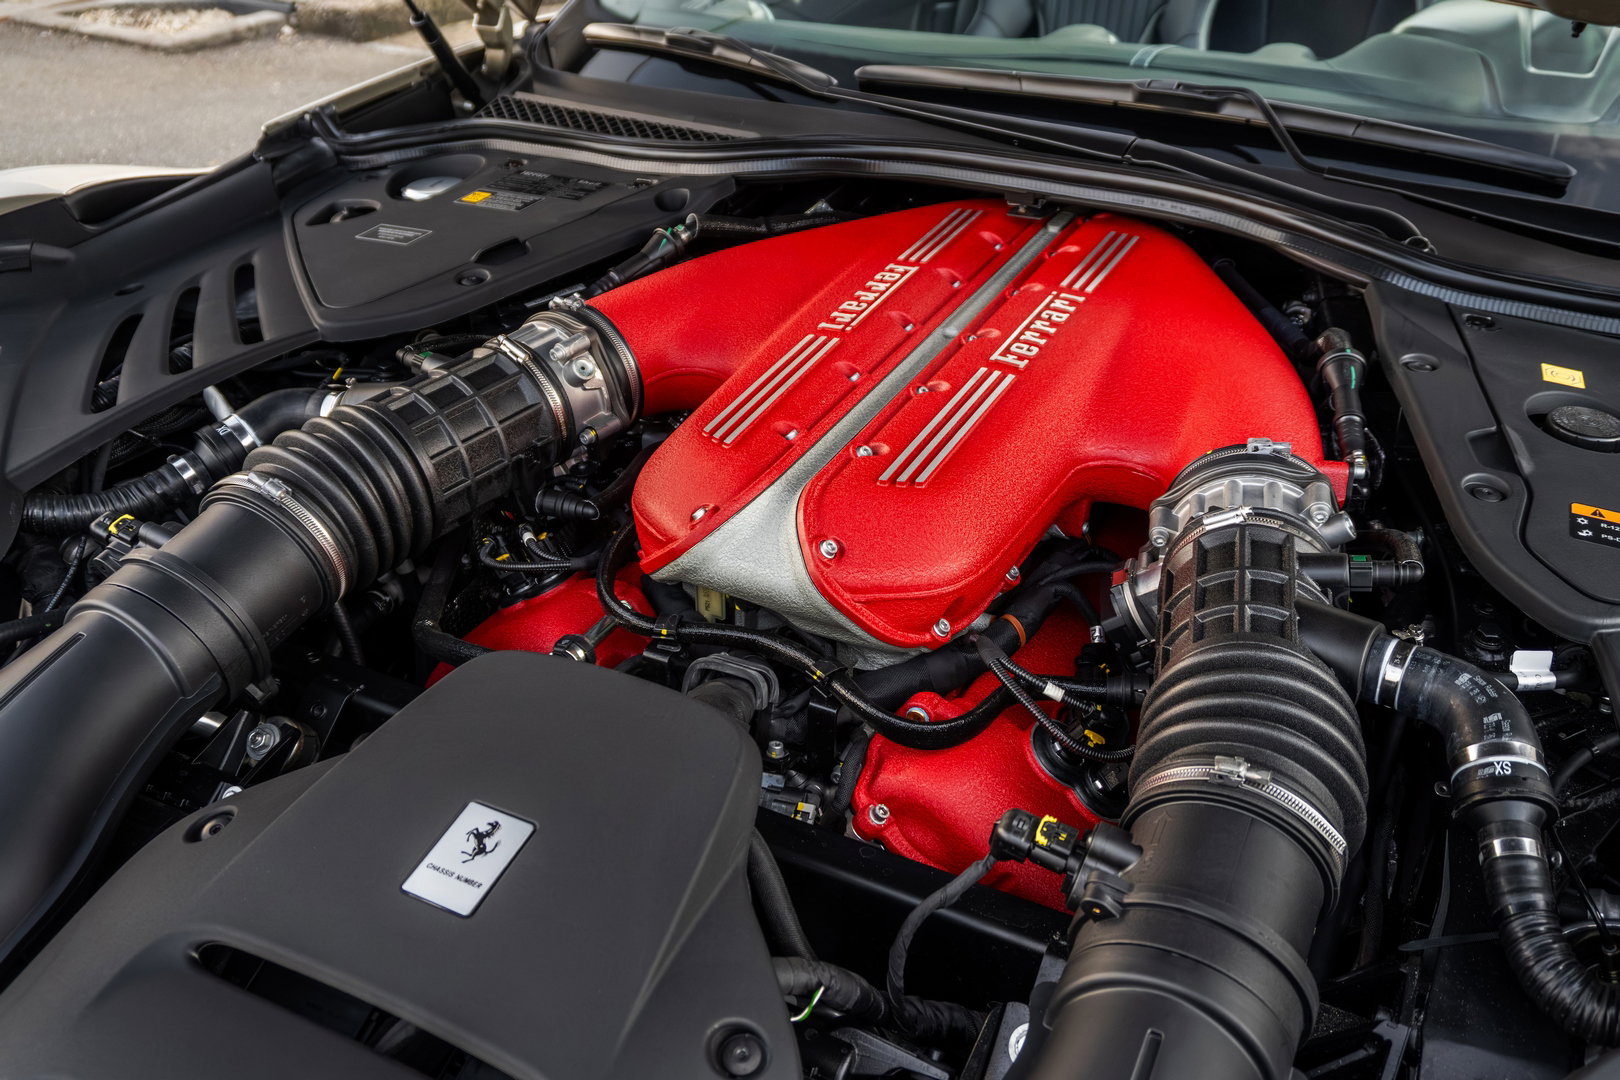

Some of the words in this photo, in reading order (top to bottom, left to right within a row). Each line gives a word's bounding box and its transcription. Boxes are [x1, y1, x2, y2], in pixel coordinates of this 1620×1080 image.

[817, 262, 920, 332] Ferrari
[989, 290, 1086, 370] Ferrari
[426, 862, 455, 878] CHASSIS
[454, 873, 483, 889] NUMBER
